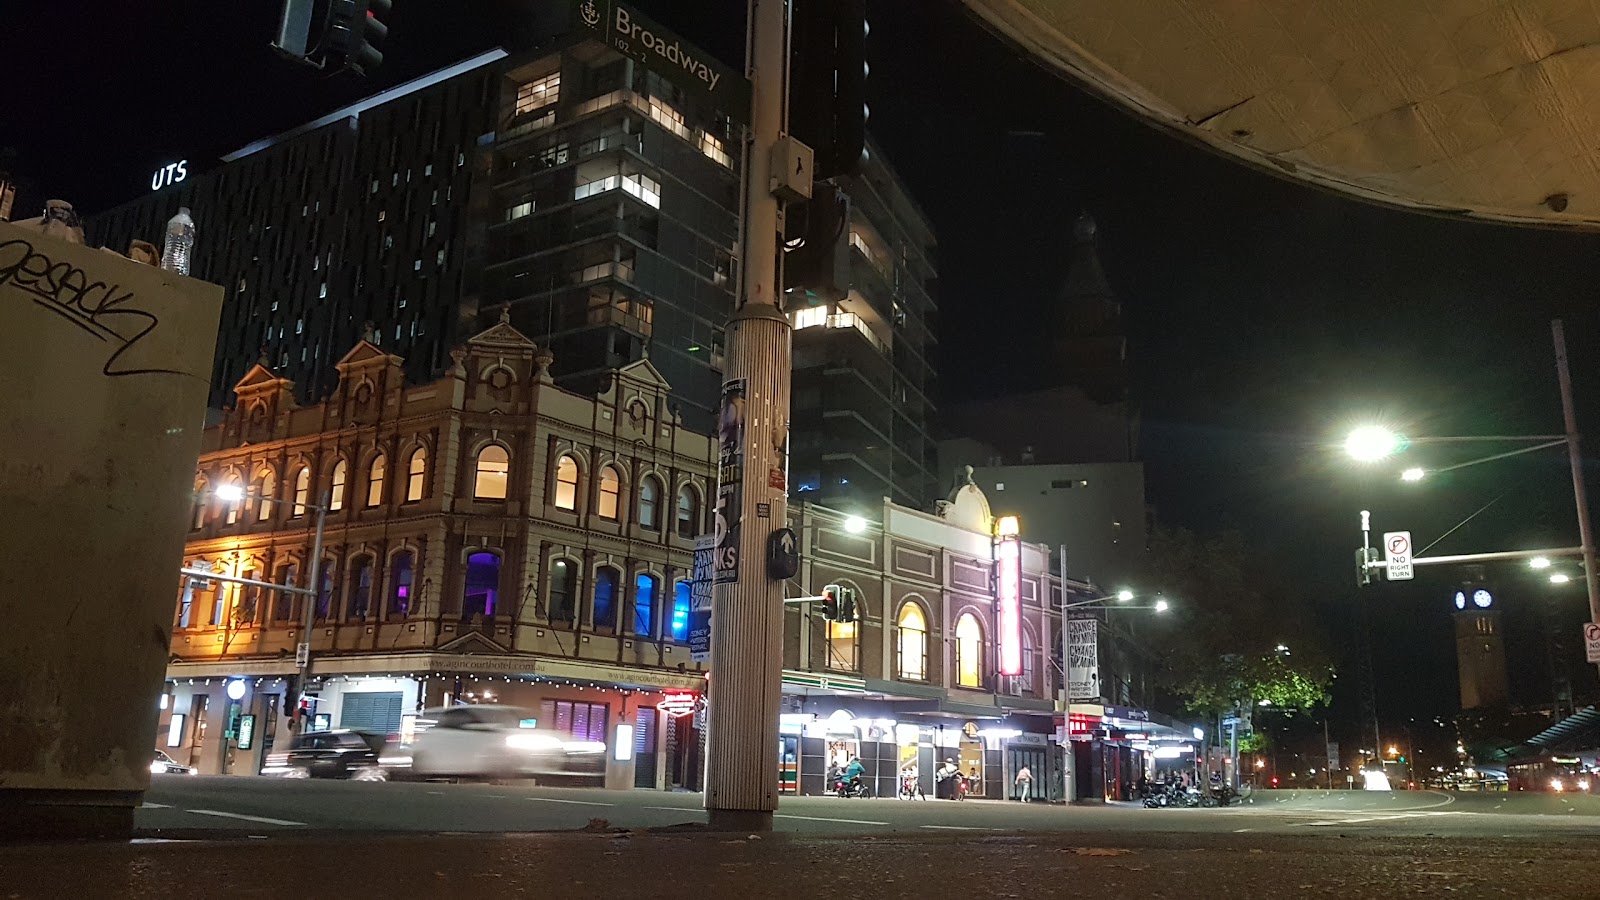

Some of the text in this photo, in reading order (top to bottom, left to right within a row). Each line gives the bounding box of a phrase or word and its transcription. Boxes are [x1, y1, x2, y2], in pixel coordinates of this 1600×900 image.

[614, 37, 629, 53] 102
[616, 6, 720, 91] Broadway
[151, 159, 187, 191] UTS
[1069, 621, 1096, 634] CHANGE
[423, 659, 546, 672] www.agincourthotel.com.au
